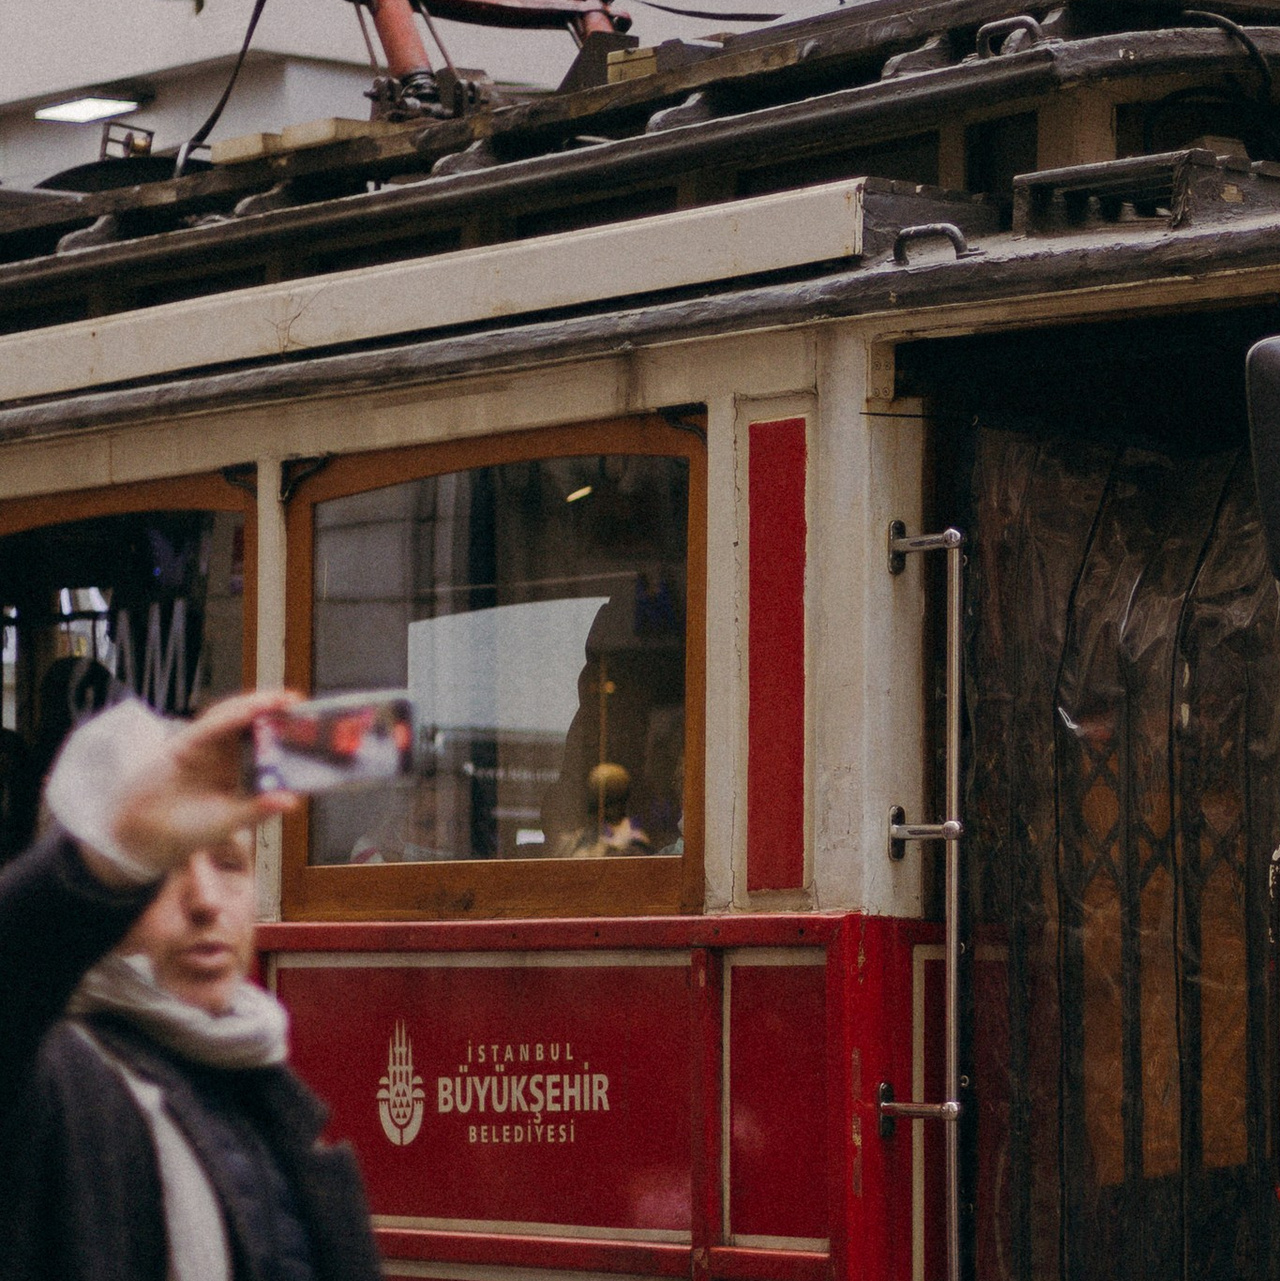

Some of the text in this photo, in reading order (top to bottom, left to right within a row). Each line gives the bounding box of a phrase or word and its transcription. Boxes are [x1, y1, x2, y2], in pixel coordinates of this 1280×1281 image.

[467, 1040, 573, 1062] İSTANBUL
[438, 1062, 610, 1123] BÜYÜKŞEHİR
[469, 1120, 574, 1143] BELEDİYESİ
